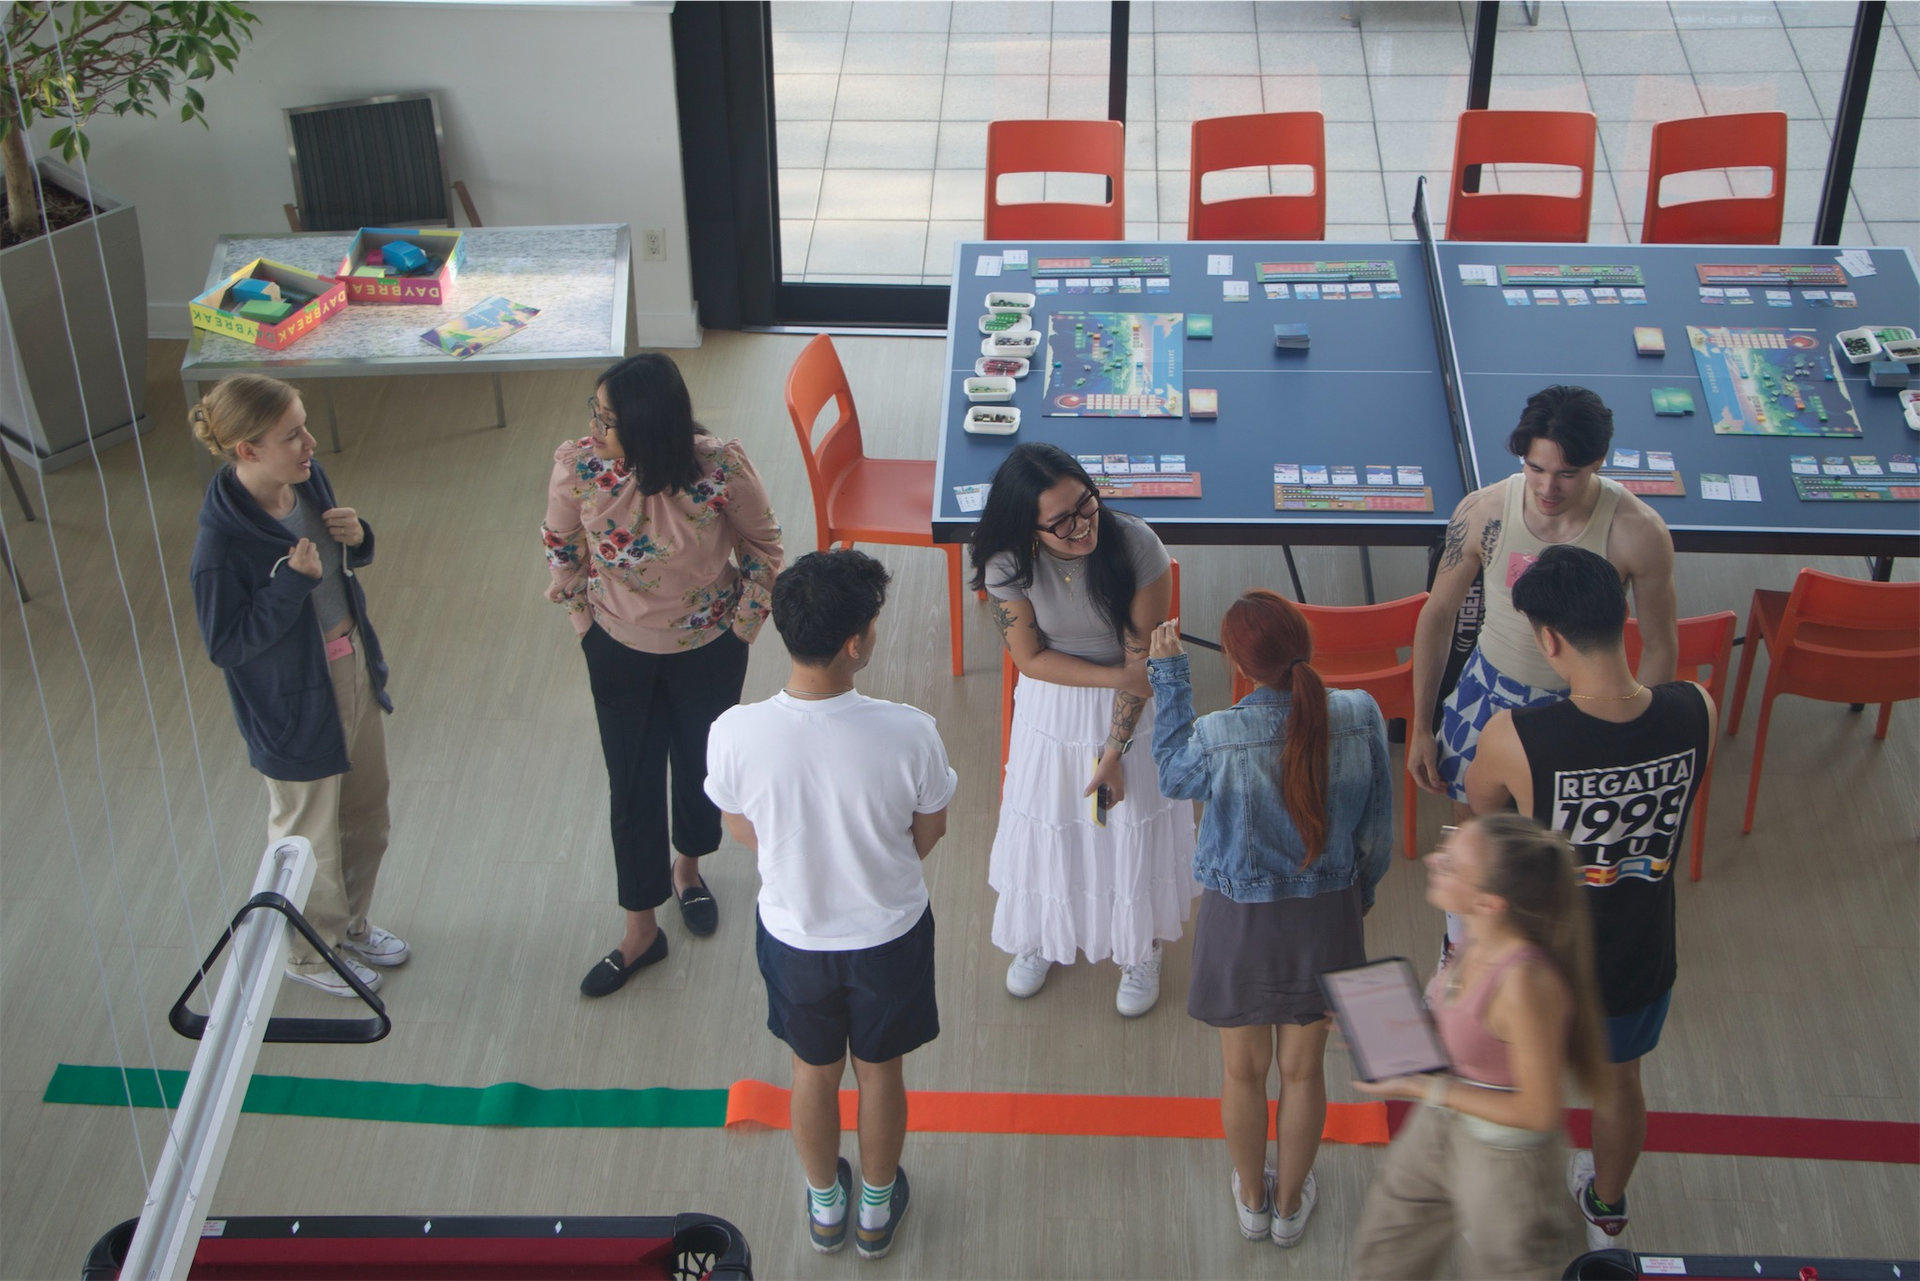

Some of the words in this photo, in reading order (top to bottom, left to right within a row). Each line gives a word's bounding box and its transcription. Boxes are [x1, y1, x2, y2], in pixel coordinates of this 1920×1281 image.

[348, 283, 440, 298] DAYBREA
[193, 309, 276, 344] DAYBREAK
[279, 290, 347, 342] DAYBREAK
[1562, 759, 1690, 798] REGATTA
[1559, 784, 1687, 843] 1998
